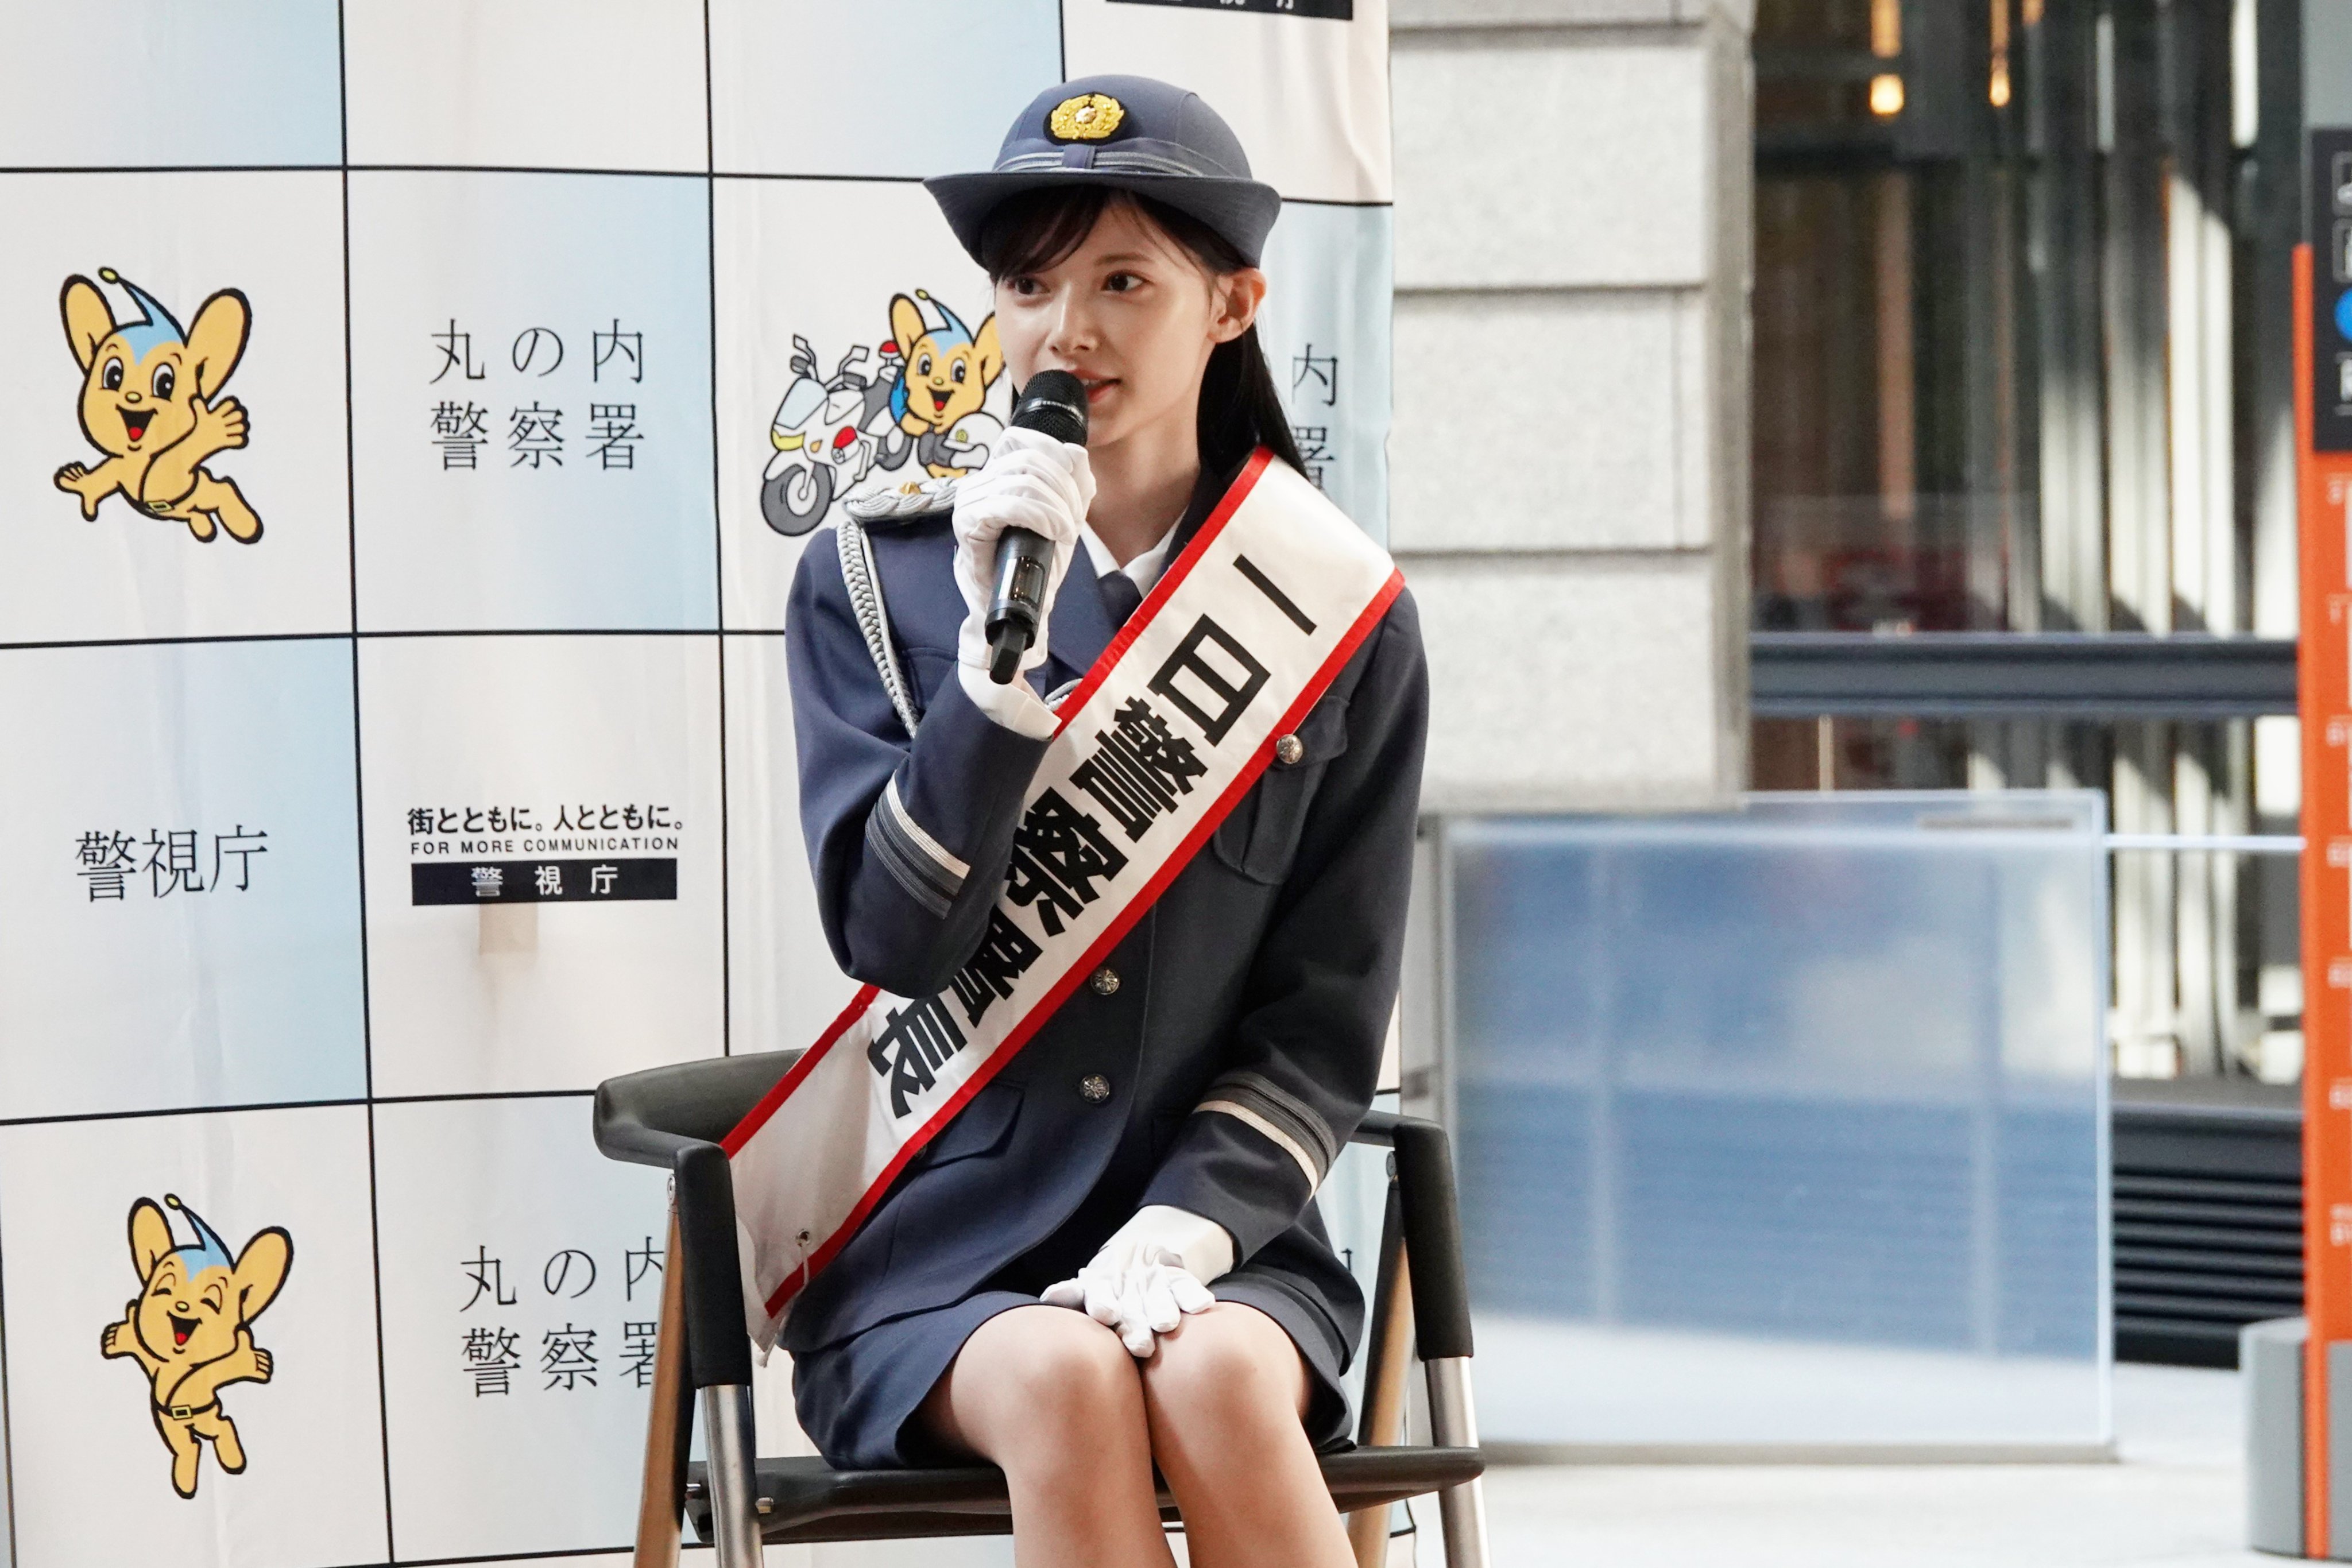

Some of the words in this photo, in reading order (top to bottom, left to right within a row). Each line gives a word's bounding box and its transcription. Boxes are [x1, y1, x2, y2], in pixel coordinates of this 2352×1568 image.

[429, 318, 643, 385] 丸の内
[430, 400, 644, 471] 警察署
[75, 823, 268, 903] 警視庁
[411, 841, 450, 855] FOR
[461, 839, 514, 854] MORE
[524, 837, 679, 851] COMMUNICATION
[471, 864, 618, 897] 警視庁
